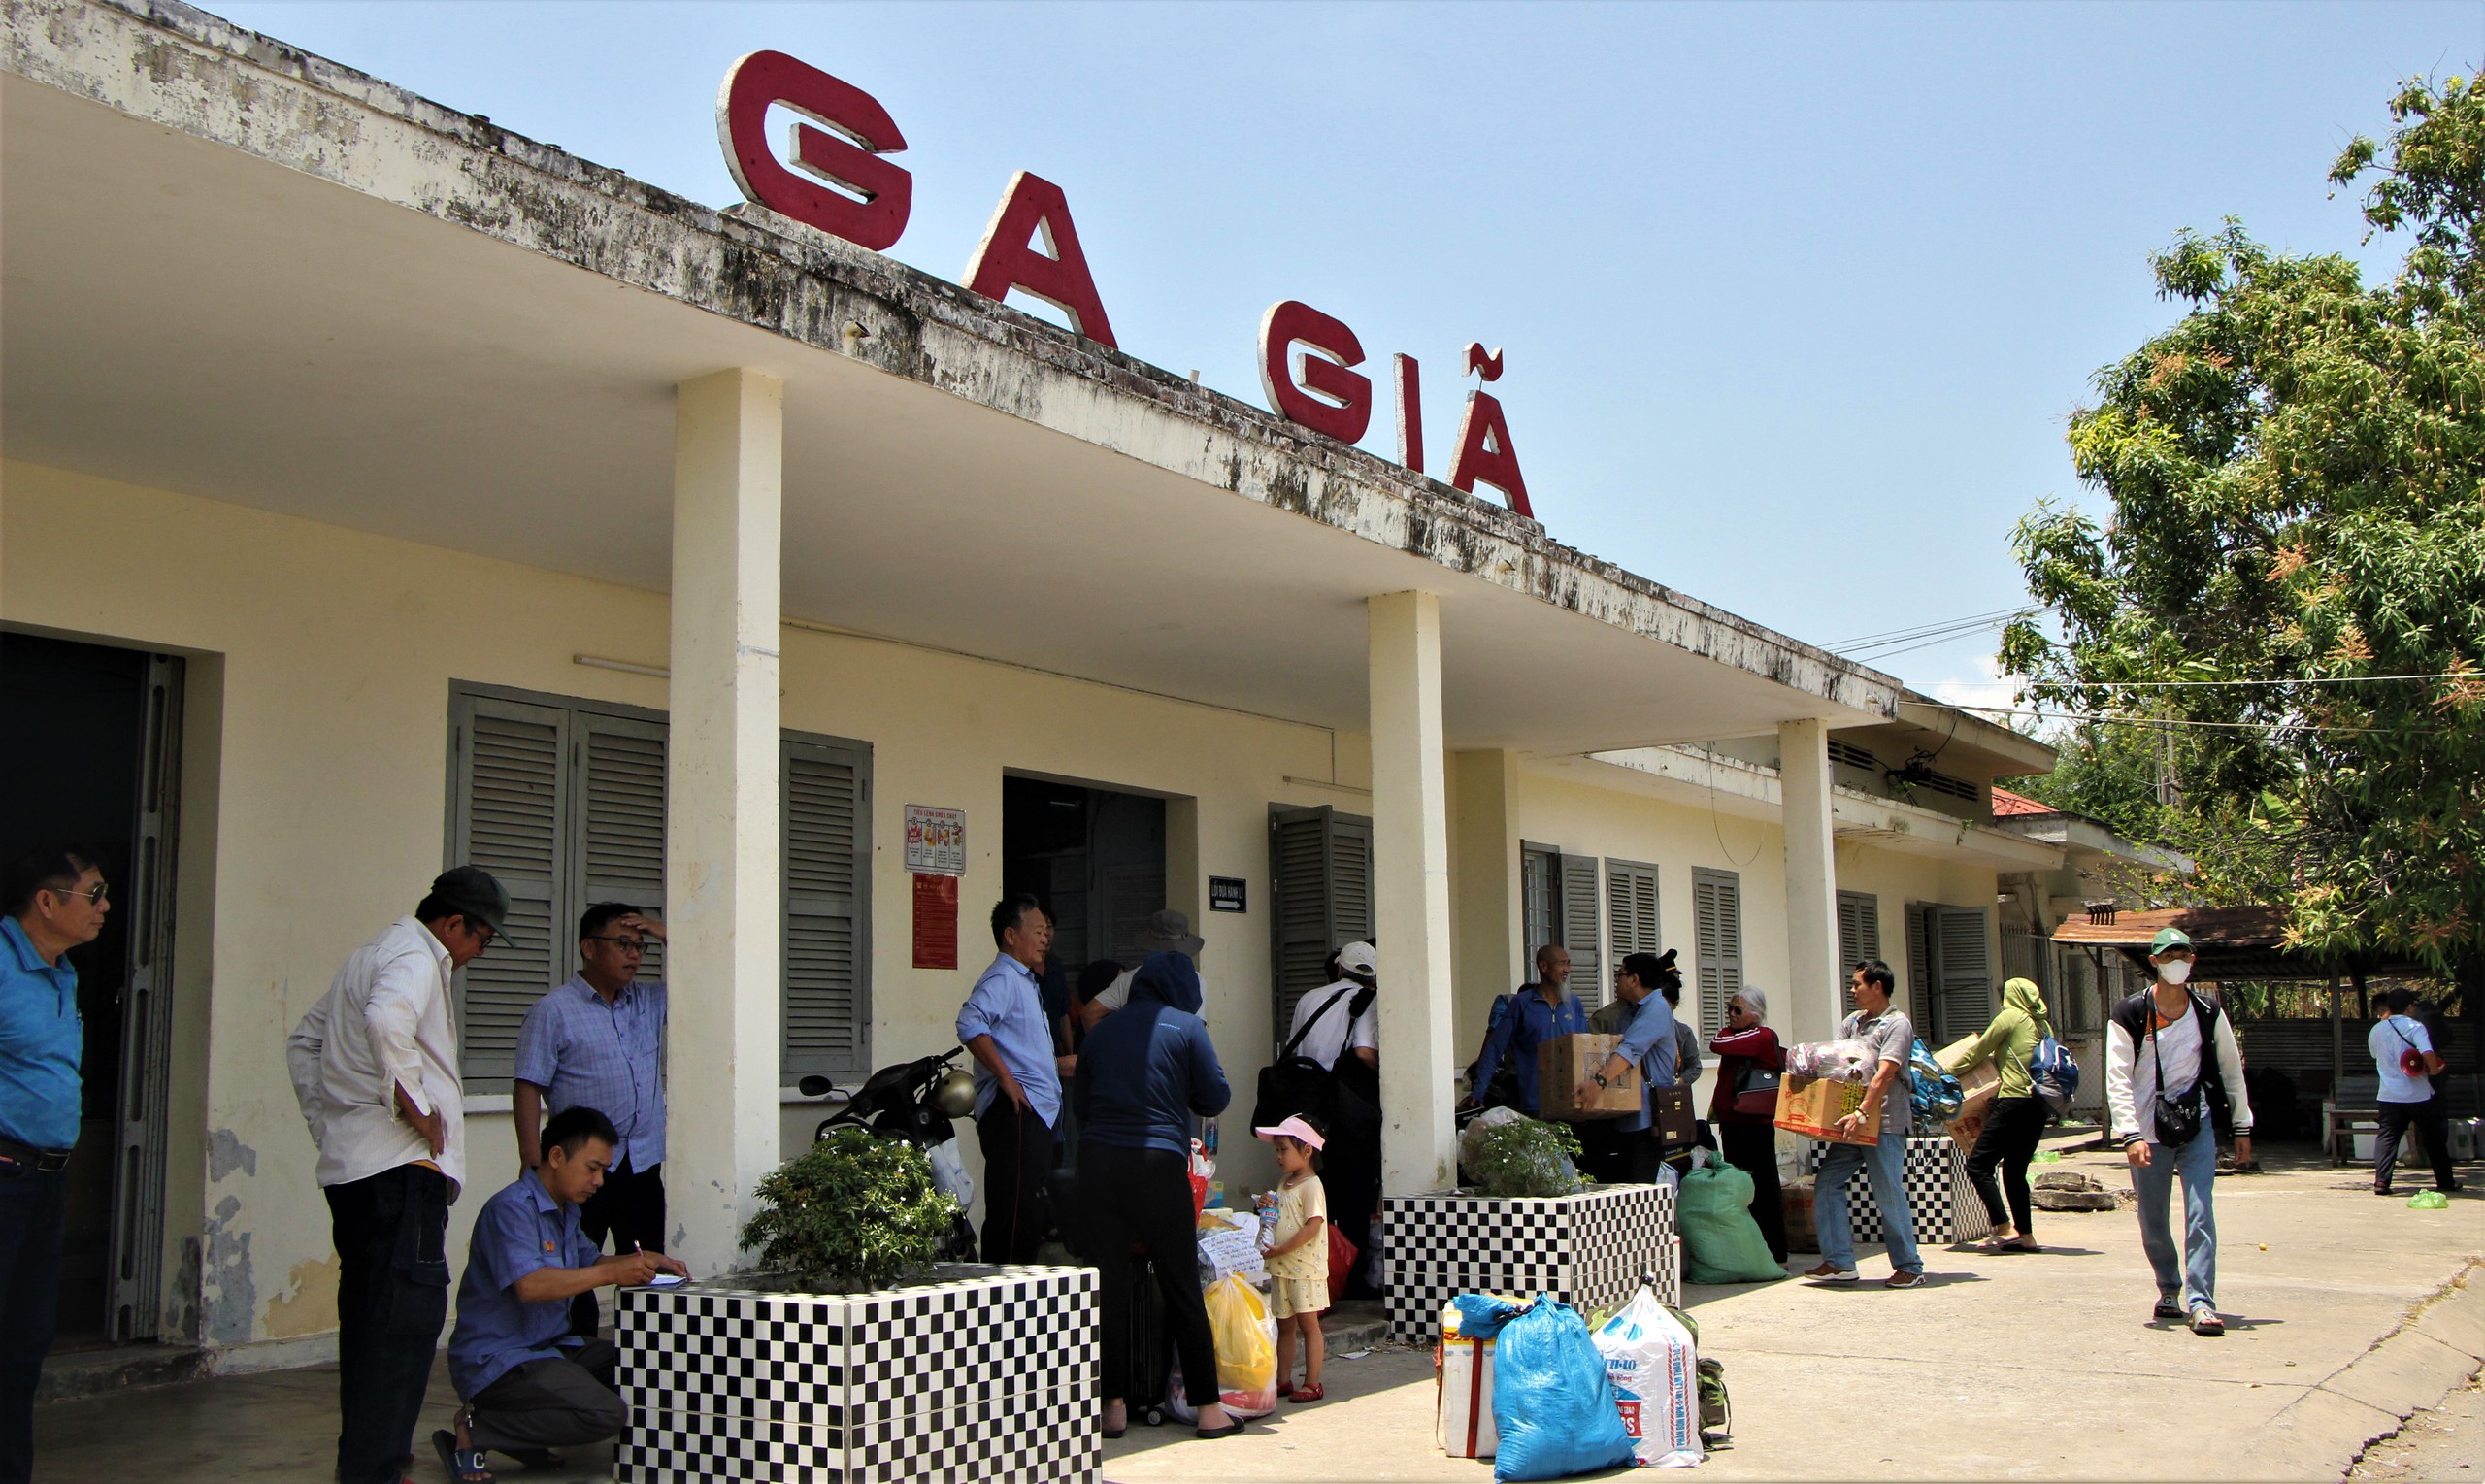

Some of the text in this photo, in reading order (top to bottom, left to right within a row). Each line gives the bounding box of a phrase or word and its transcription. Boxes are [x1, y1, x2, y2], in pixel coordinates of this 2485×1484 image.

[715, 49, 1535, 520] GA GIÃ
[1674, 1431, 1685, 1447] PHÂN
[473, 1452, 485, 1469] C
